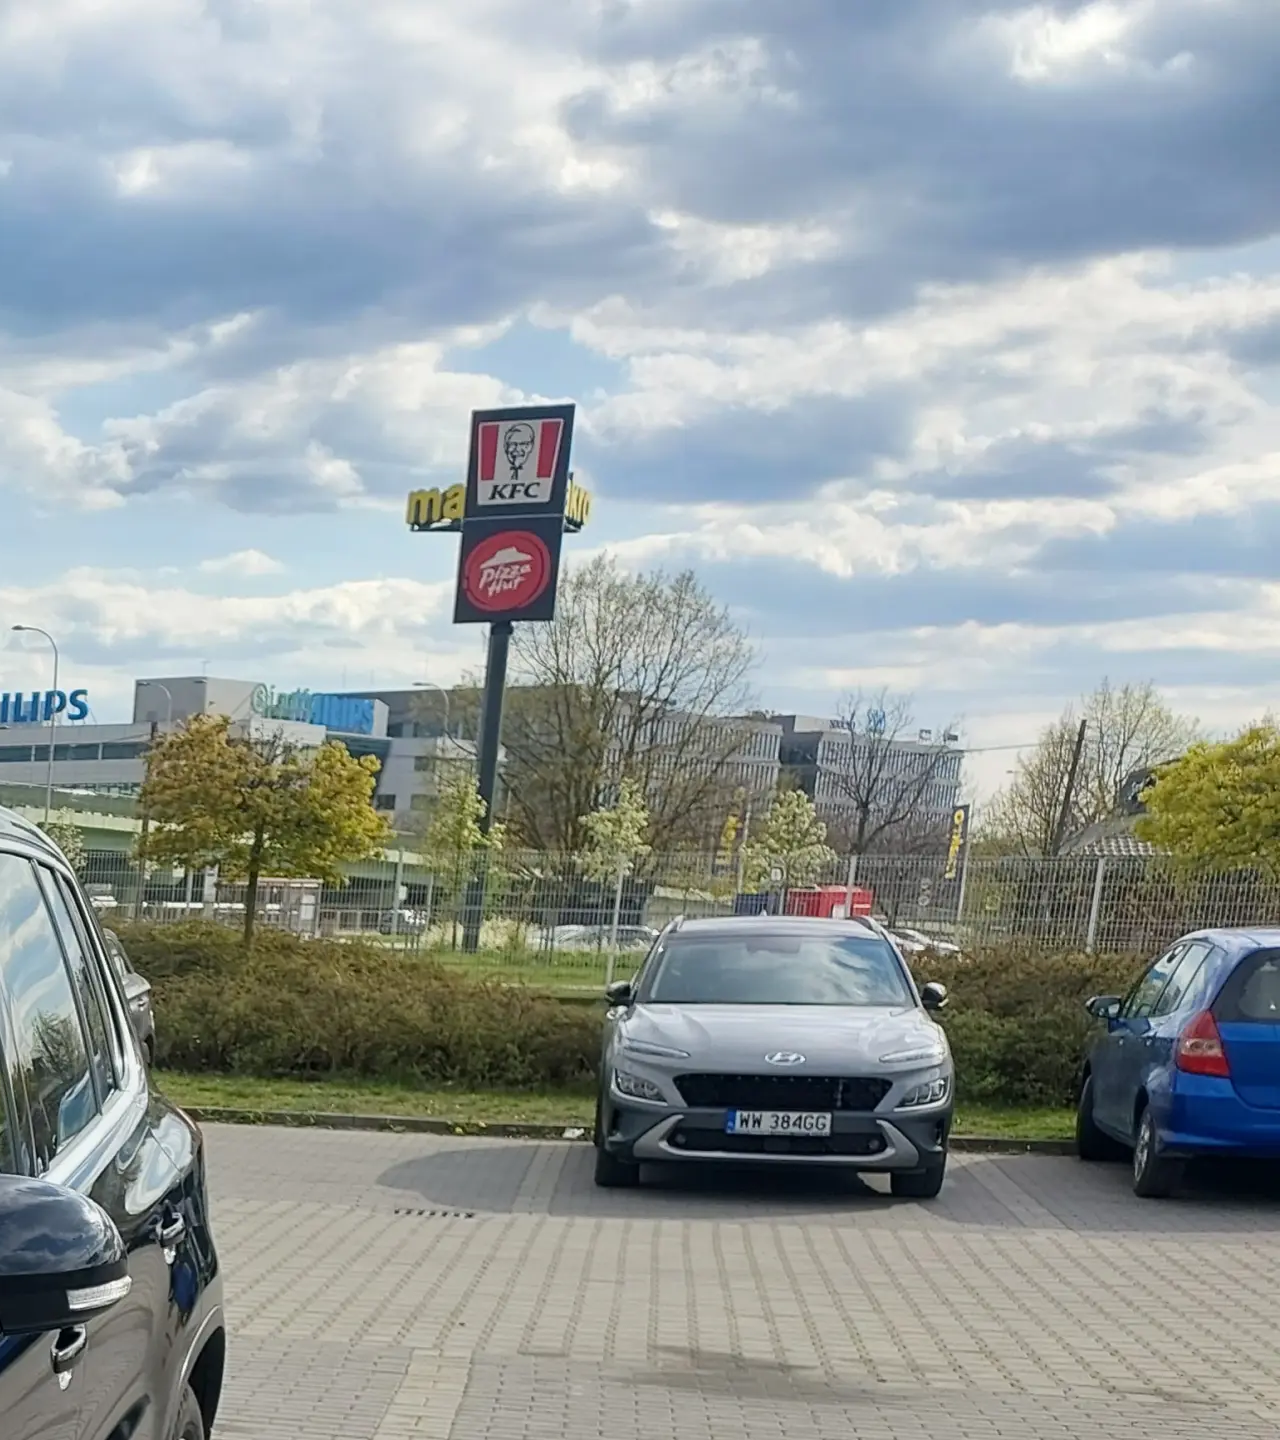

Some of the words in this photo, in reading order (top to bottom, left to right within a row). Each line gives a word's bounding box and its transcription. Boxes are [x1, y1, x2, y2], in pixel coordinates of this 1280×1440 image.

[488, 482, 542, 501] KFC
[479, 563, 533, 590] Pizza
[488, 576, 526, 598] Hut
[740, 1112, 763, 1129] WW
[770, 1113, 827, 1131] 384GG
